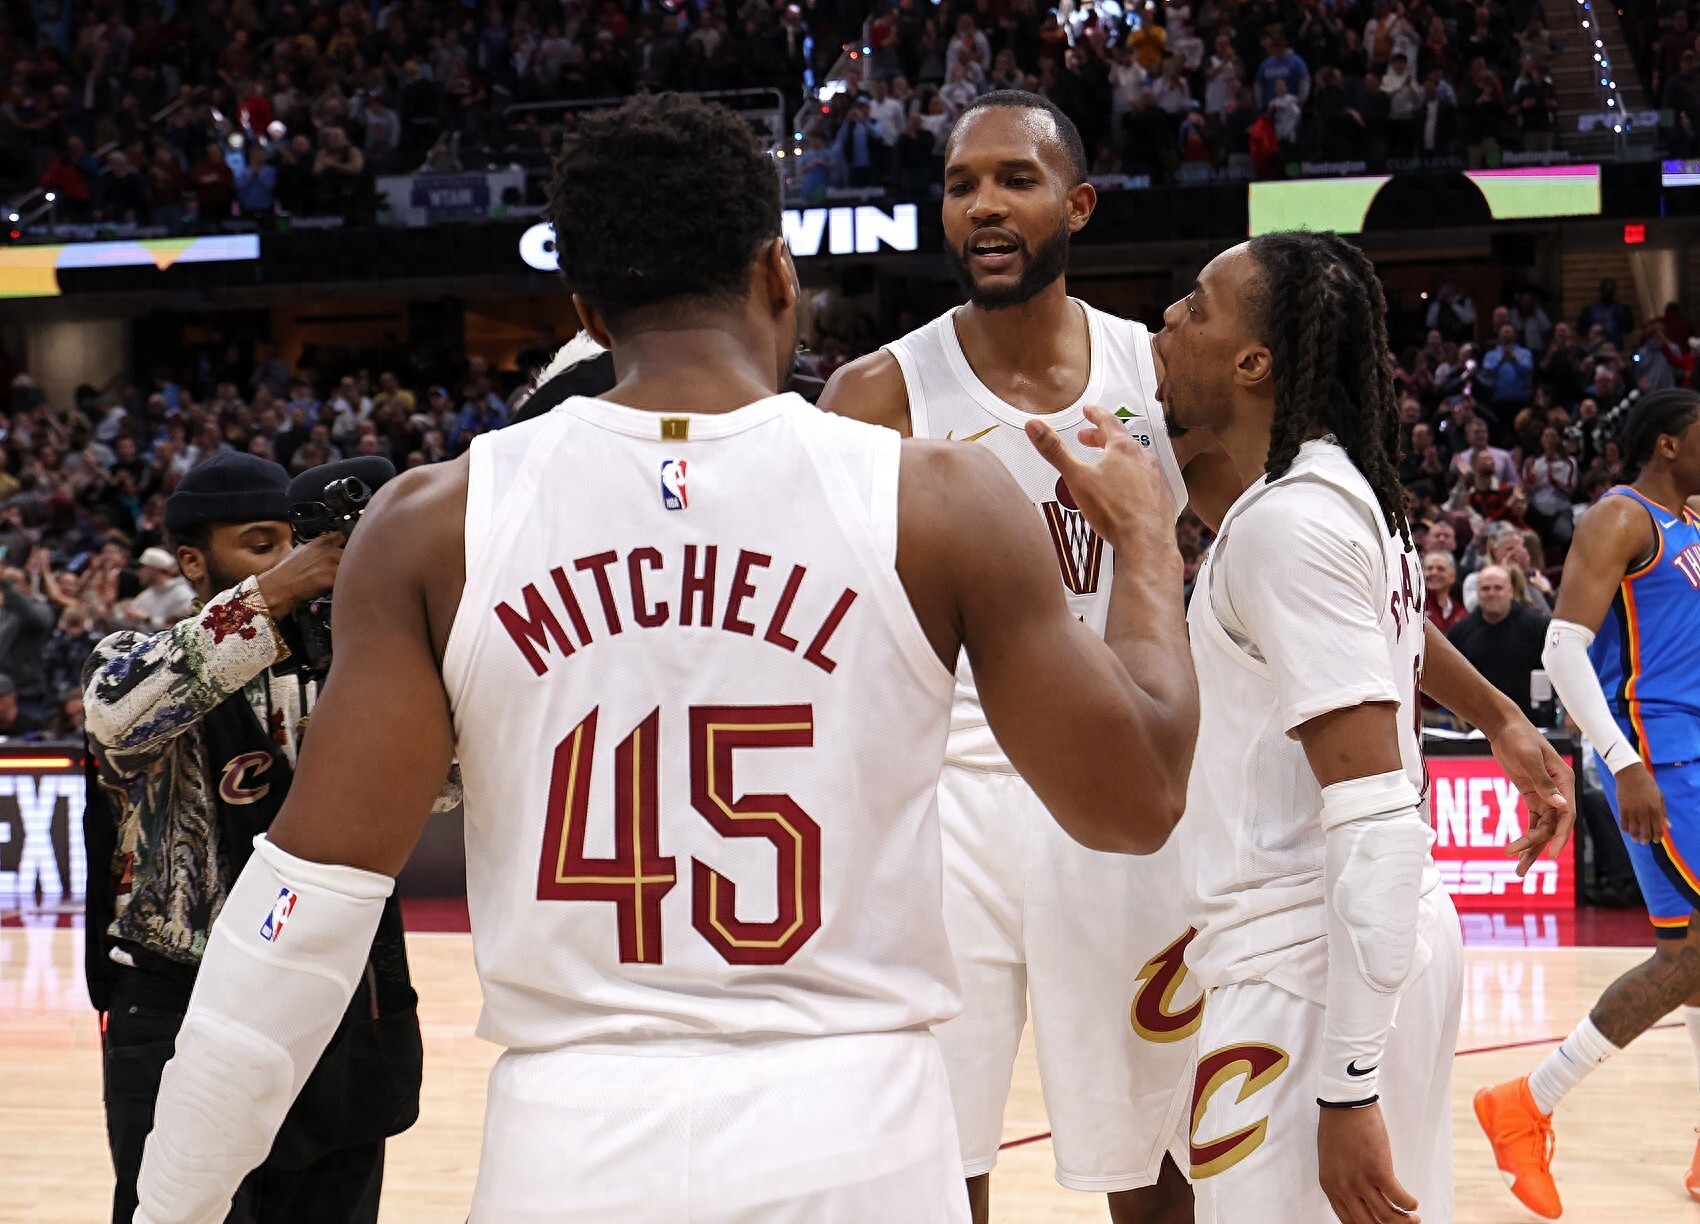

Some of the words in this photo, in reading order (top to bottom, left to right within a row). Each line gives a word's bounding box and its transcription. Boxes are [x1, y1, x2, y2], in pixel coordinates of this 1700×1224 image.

[495, 545, 858, 677] MITCHELL
[537, 704, 822, 965] 45
[1435, 860, 1558, 895] ESPN
